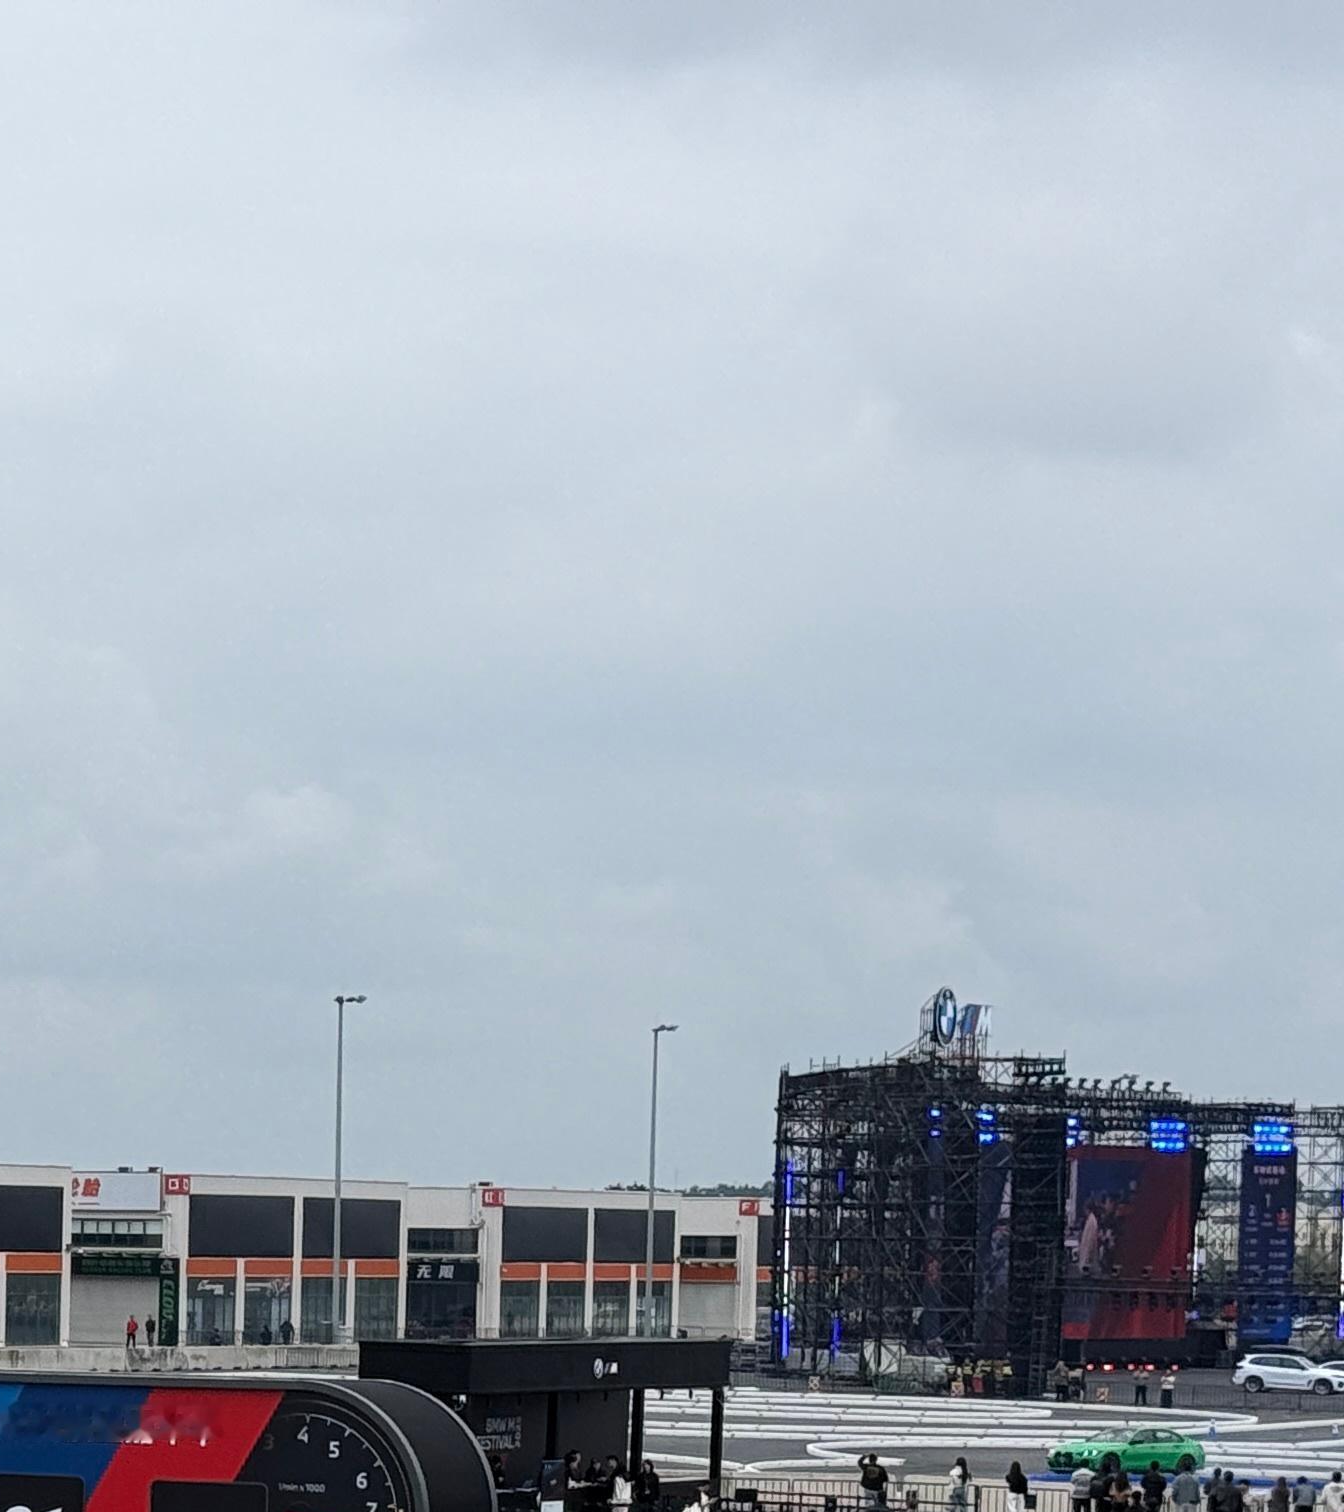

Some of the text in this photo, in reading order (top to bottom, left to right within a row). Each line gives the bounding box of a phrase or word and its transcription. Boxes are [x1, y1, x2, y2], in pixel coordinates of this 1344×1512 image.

[297, 1426, 309, 1443] 4
[328, 1441, 340, 1458] 5
[305, 1483, 326, 1493] 1000
[355, 1473, 368, 1489] 6
